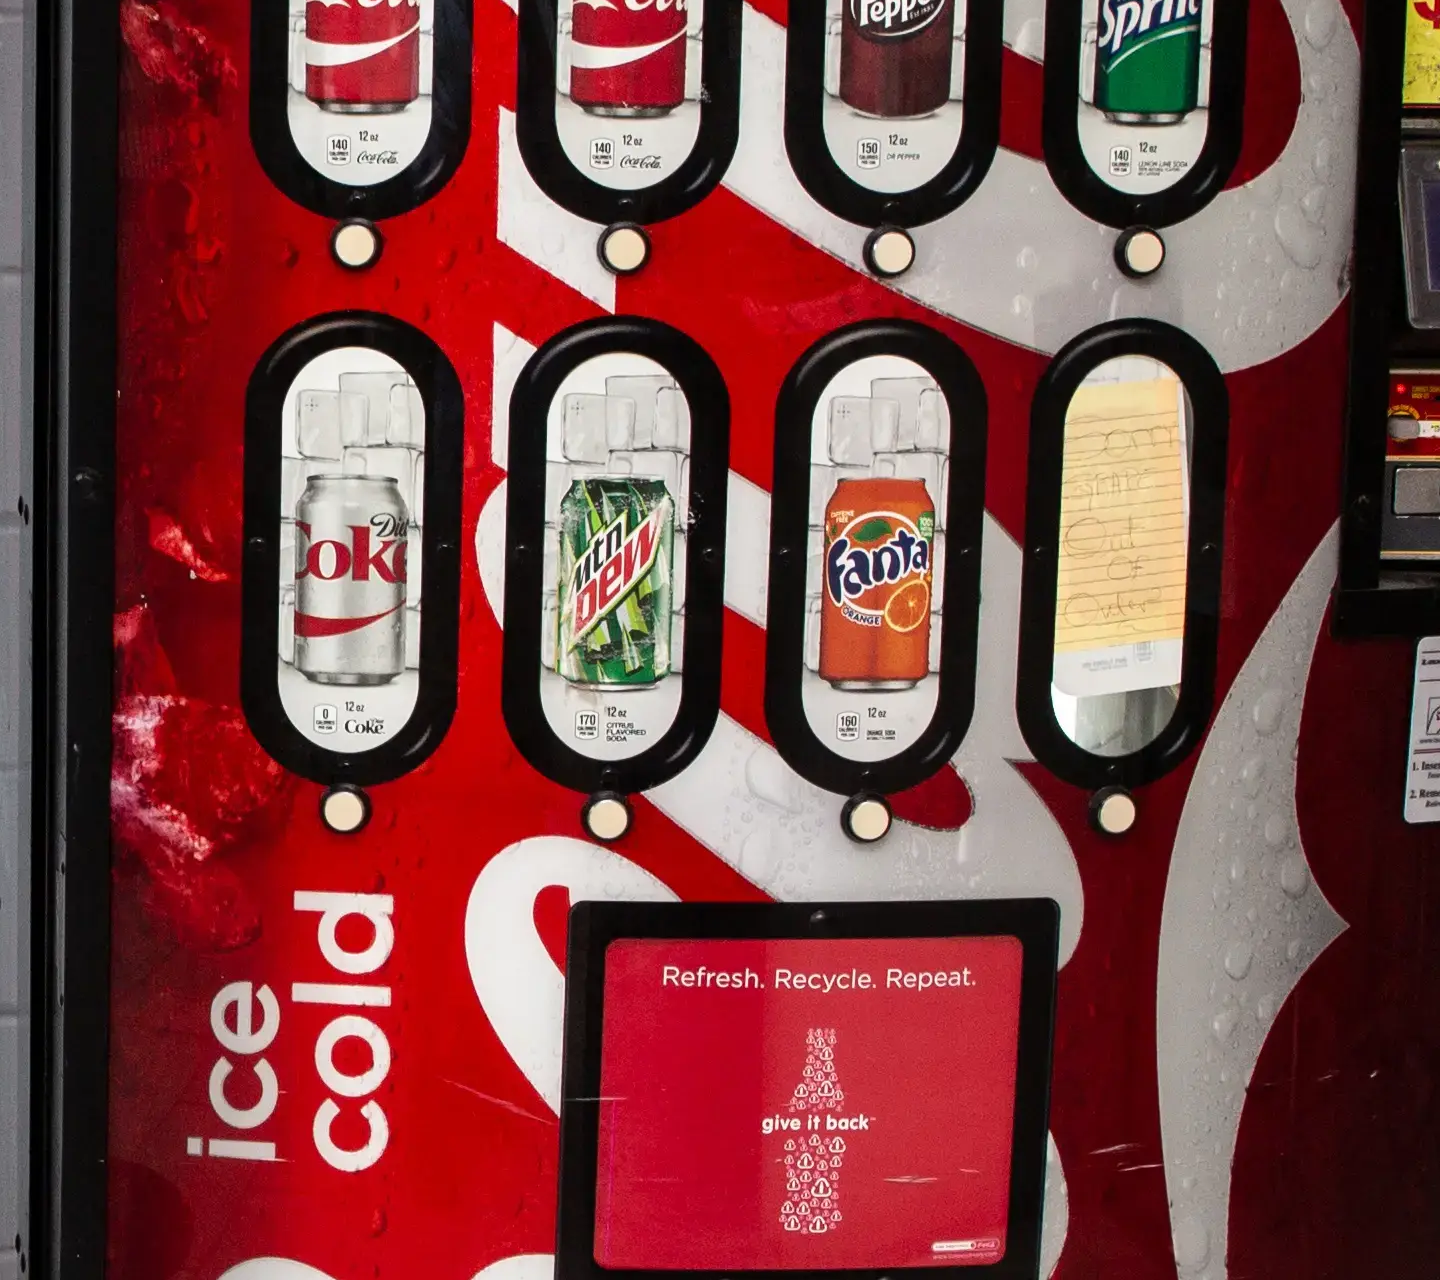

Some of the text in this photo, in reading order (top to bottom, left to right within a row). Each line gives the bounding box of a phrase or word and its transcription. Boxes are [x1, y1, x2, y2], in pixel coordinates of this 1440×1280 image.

[359, 130, 379, 142] 12 oz
[623, 134, 643, 146] 12 oz
[888, 134, 908, 146] 12 oz
[331, 139, 348, 150] 140
[595, 142, 611, 154] 140
[861, 142, 878, 154] 150
[1139, 141, 1157, 153] 12 oz
[620, 154, 662, 168] Coca-Cola
[1114, 150, 1129, 161] 140
[828, 528, 928, 606] Fanta
[842, 605, 880, 625] ORANGE
[345, 701, 365, 712] 12 oz
[607, 706, 617, 718] 12
[867, 707, 887, 718] 12 oz
[322, 708, 329, 719] 0
[579, 714, 596, 725] 170
[344, 719, 385, 734] Coke
[840, 715, 857, 727] 160
[1412, 762, 1419, 771] 1.
[1409, 789, 1417, 798] 2.
[662, 965, 977, 993] Refresh. Recycle. Repeat.
[291, 890, 395, 1173] cold
[186, 980, 281, 1162] ice
[762, 1114, 870, 1135] give it back
